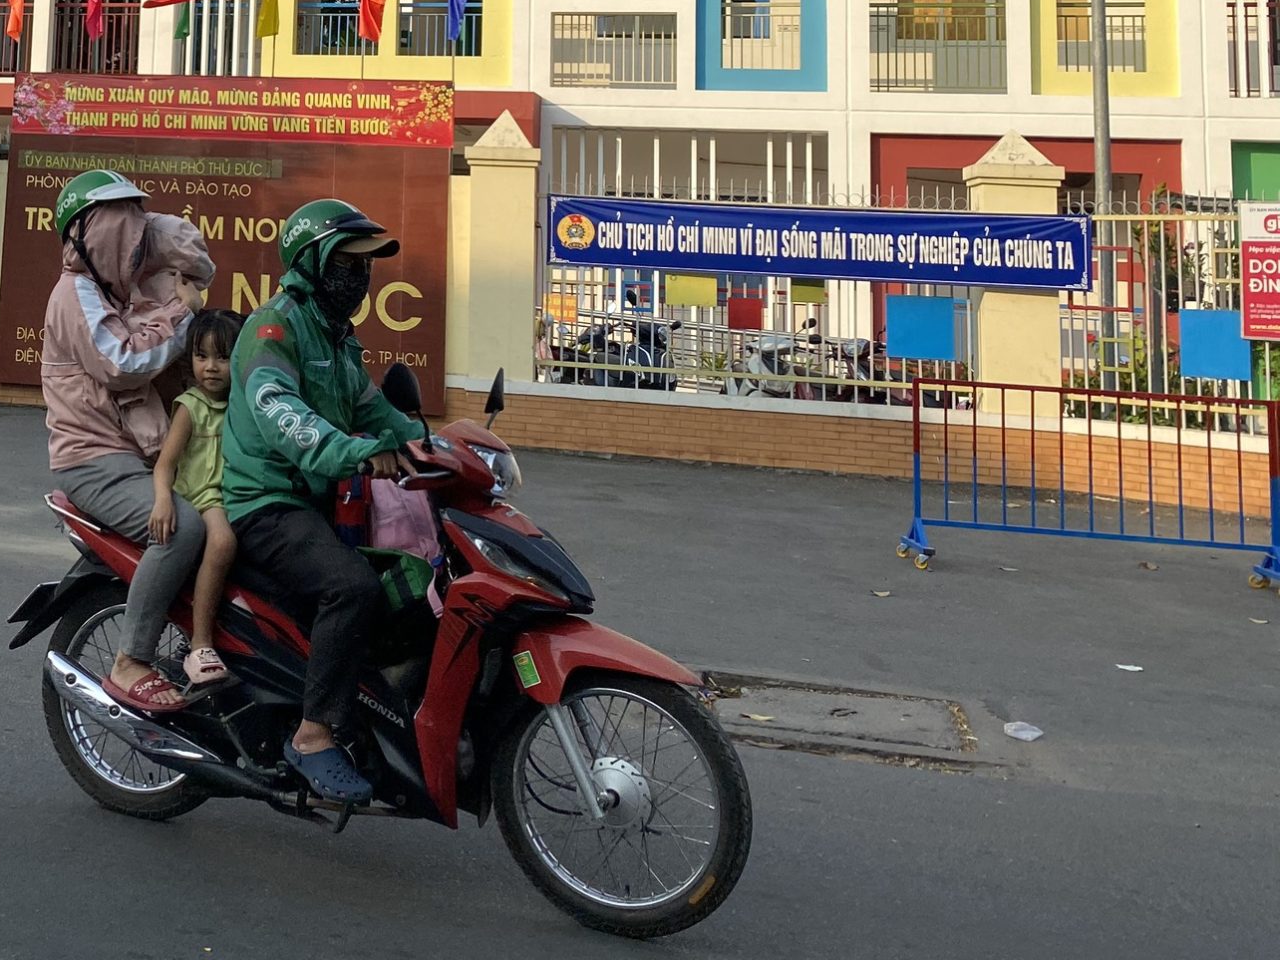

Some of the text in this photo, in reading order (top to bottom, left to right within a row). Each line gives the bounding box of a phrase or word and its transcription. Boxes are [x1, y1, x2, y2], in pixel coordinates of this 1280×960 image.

[65, 84, 395, 111] MỪNG XUÂN QUÝ MÃO, MỪNG ĐẢNG QUANG VINH,
[65, 110, 108, 127] THÀNH
[111, 108, 139, 128] PHỐ
[142, 108, 160, 129] HỒ
[164, 112, 187, 129] CHÍ
[190, 115, 227, 131] MINH
[231, 112, 268, 132] VỮNG
[272, 114, 310, 133] VÀNG
[314, 114, 346, 134] TIẾN
[45, 155, 69, 169] BAN
[72, 155, 105, 170] NHÂN
[108, 156, 135, 172] DÂN
[139, 159, 177, 173] THÀNH
[181, 158, 205, 174] PHỐ
[208, 158, 231, 176] THỦ
[234, 161, 263, 177] ĐỨC
[159, 178, 180, 194] VÀ
[185, 179, 219, 196] ĐÀO
[222, 183, 252, 199] TẠO
[56, 192, 77, 218] Grab
[234, 216, 285, 243] NO
[282, 217, 311, 248] Grab
[597, 211, 1075, 271] CHỦ TỊCH HỒ CHÍ MINH VĨ ĐẠI SỐNG MÃI TRONG SỰ NGHIỆP CỦA CHÚNG TA
[1248, 259, 1280, 274] DO
[16, 326, 36, 343] ĐỊA
[255, 383, 320, 449] Grab
[357, 692, 406, 729] HONDA
